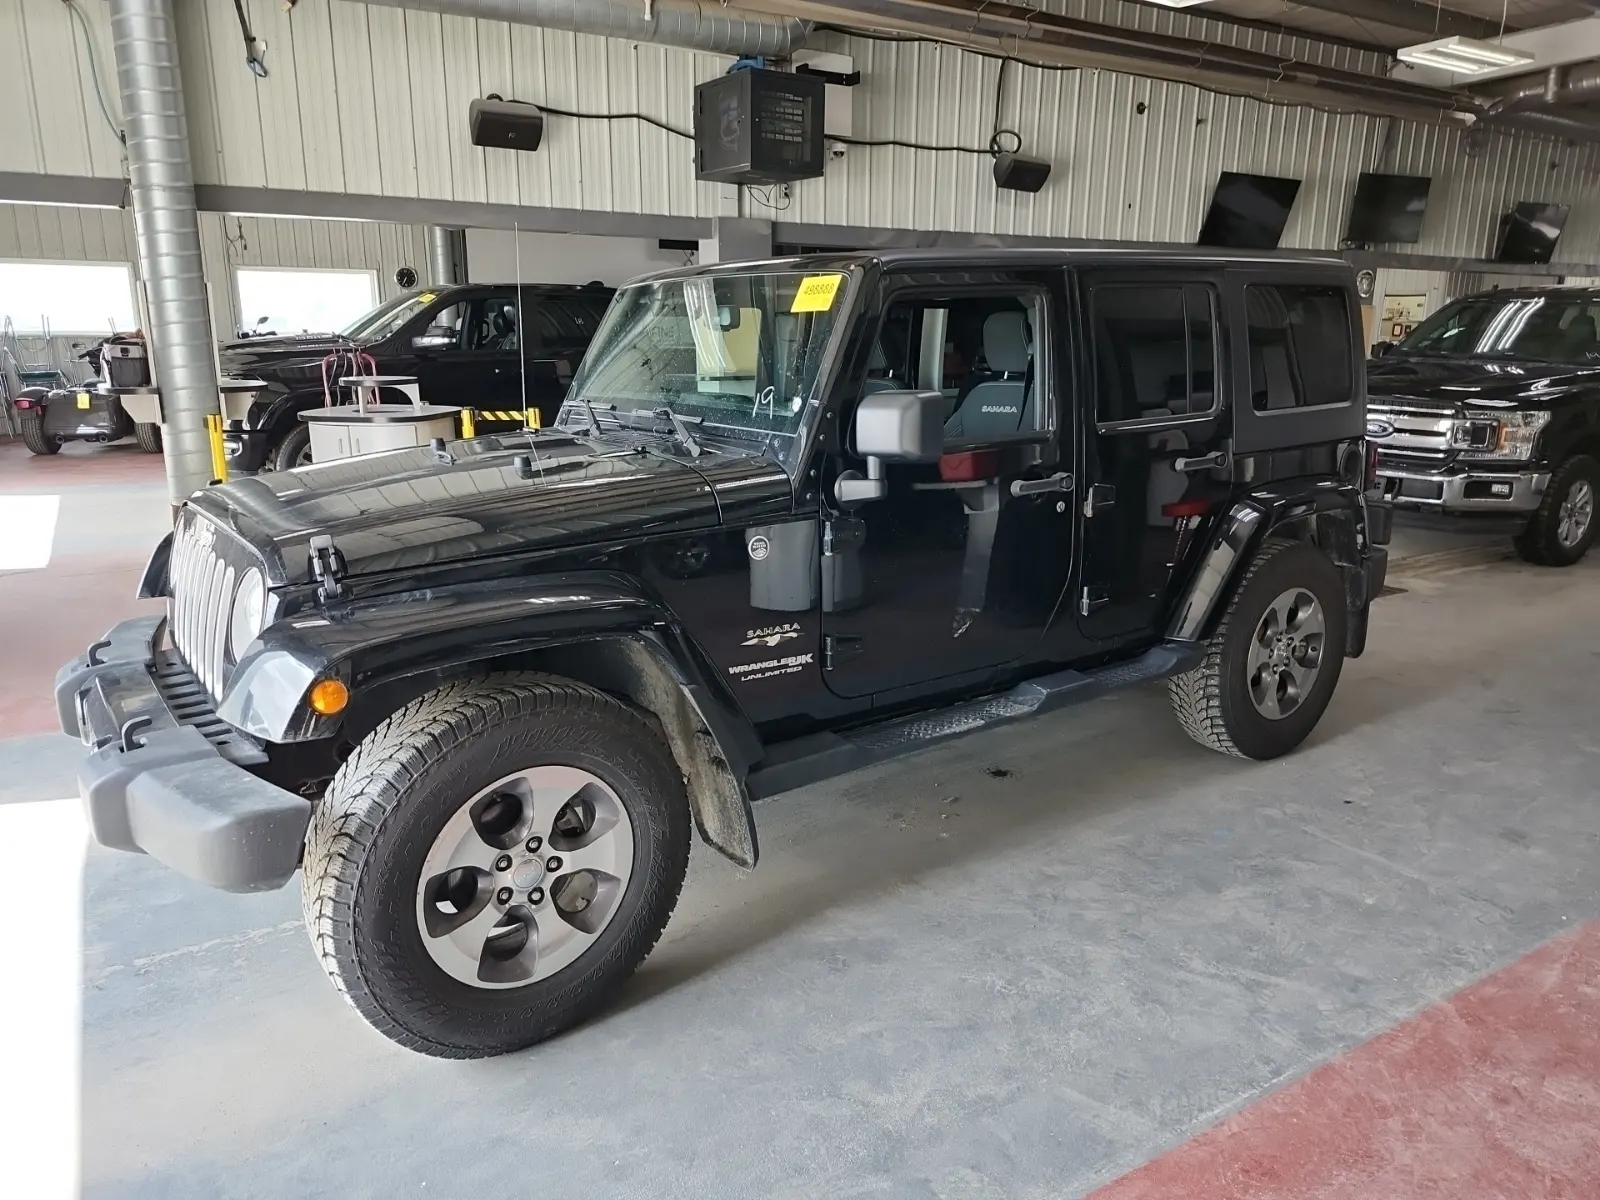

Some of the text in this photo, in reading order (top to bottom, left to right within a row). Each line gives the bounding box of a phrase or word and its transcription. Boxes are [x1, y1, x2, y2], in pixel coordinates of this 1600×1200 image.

[752, 385, 775, 420] 19
[746, 622, 801, 638] SAHARA
[741, 666, 802, 681] UNLIMITED
